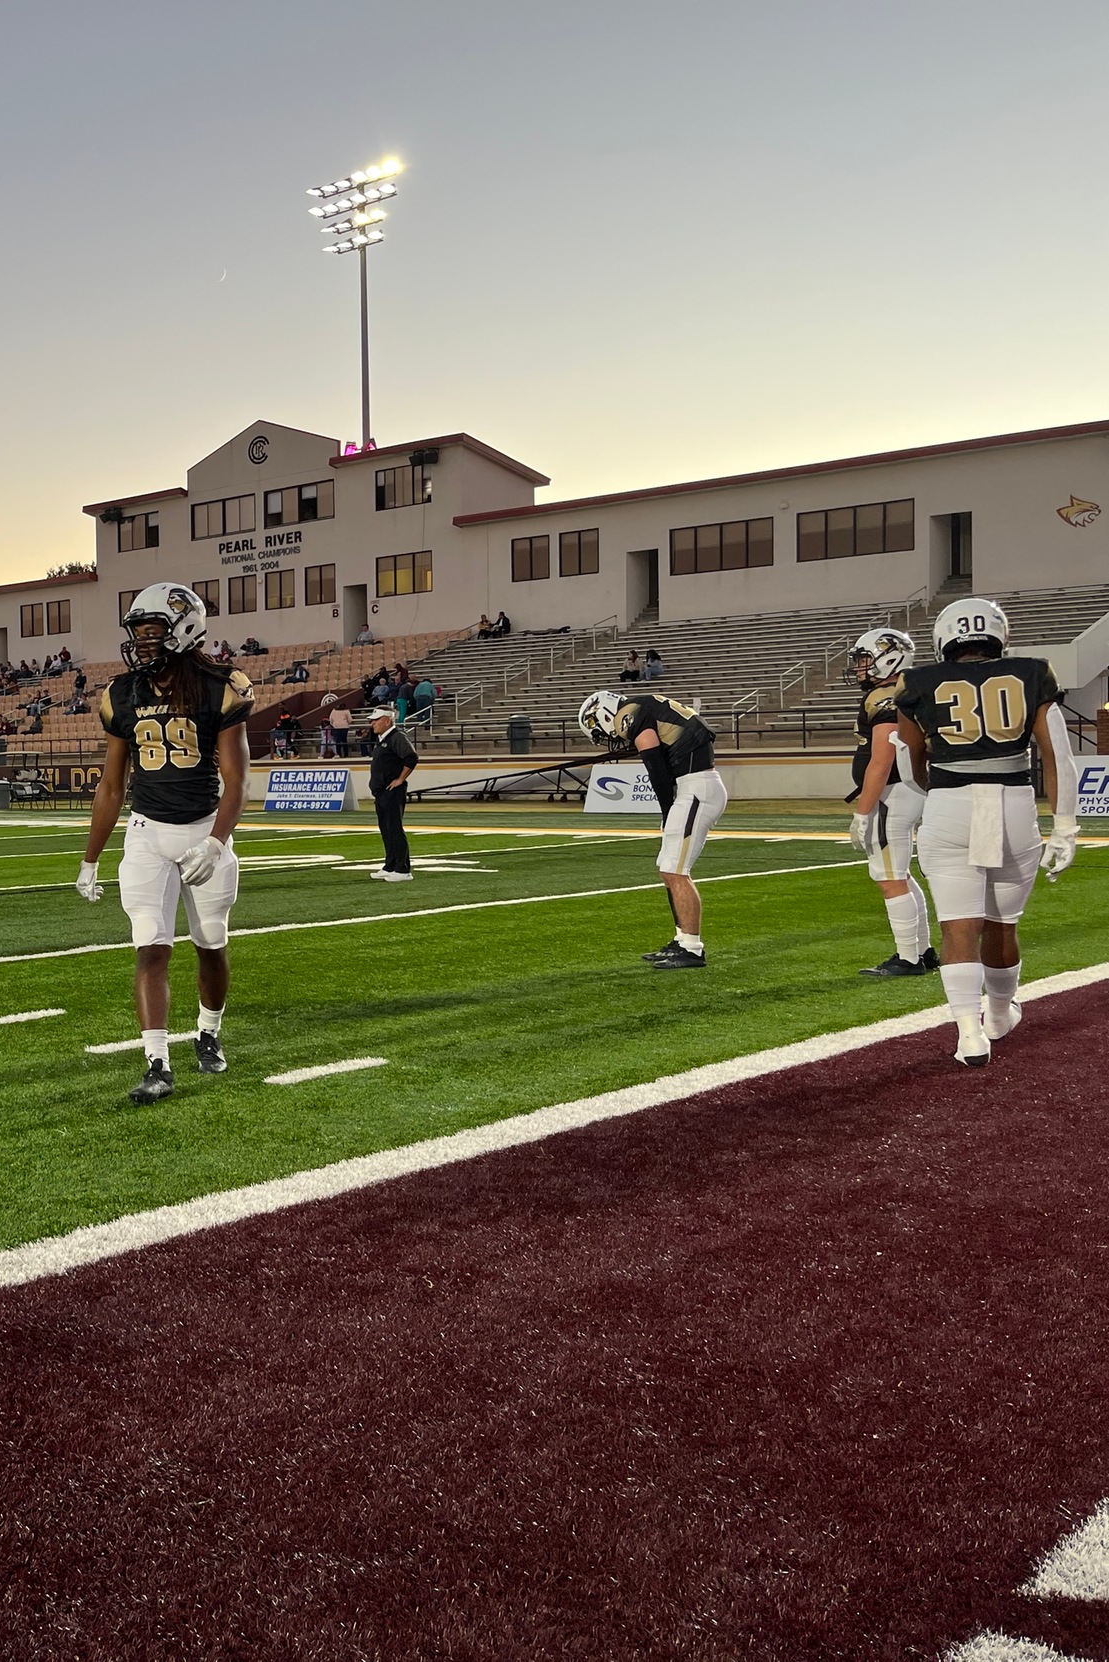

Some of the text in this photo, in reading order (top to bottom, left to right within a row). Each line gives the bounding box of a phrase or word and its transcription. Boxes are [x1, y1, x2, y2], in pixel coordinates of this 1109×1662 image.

[218, 531, 302, 555] PEARL RIVER
[221, 546, 301, 565] NATIONAL CHAMPIONS
[260, 561, 279, 571] 2004
[332, 608, 339, 618] B
[371, 604, 379, 614] C
[957, 615, 985, 634] 30
[934, 675, 1027, 745] 30
[133, 717, 201, 771] 89
[272, 771, 346, 783] CLEARMAN
[271, 783, 341, 792] INSURANCE AGENCY
[631, 794, 658, 802] SPECIA
[275, 801, 330, 810] 601-264-9974
